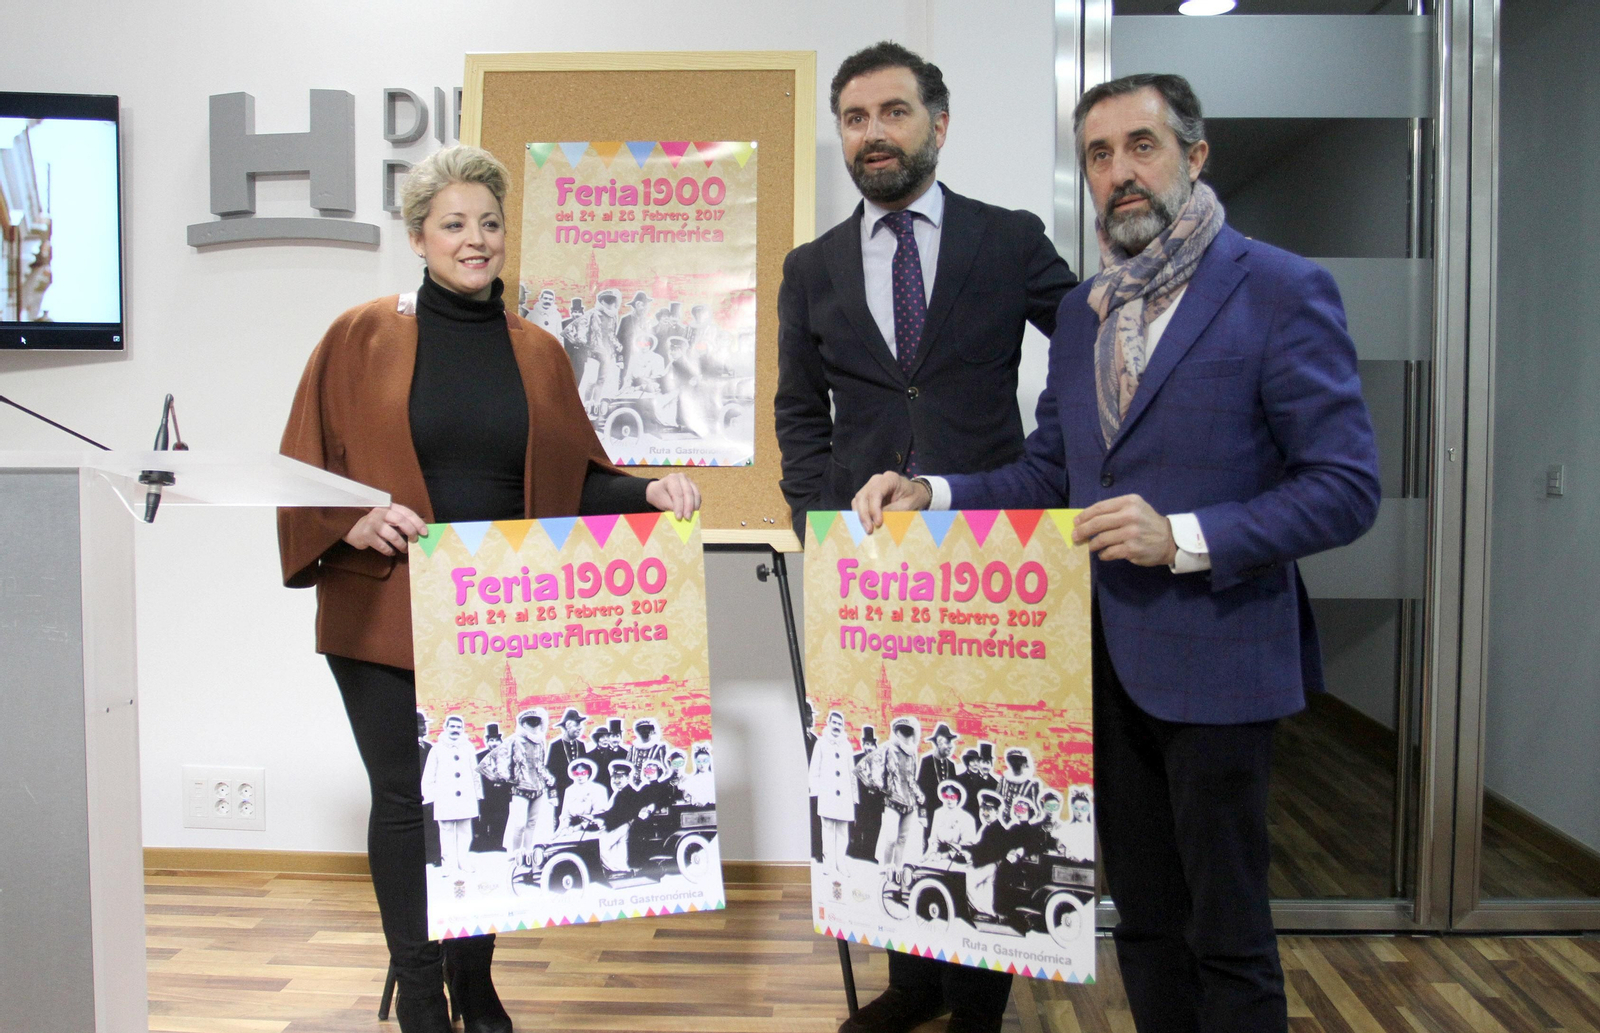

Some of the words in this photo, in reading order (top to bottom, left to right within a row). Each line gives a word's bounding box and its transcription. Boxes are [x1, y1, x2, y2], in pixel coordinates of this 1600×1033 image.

[209, 88, 356, 216] H
[555, 177, 638, 206] Feria
[641, 176, 726, 206] 1900
[555, 210, 573, 221] del
[580, 210, 595, 222] 24
[602, 210, 613, 221] al
[619, 210, 635, 221] 26
[642, 210, 689, 221] Febrero
[695, 209, 725, 221] 2017
[649, 446, 671, 455] Ruta
[451, 566, 559, 606] Feria
[561, 557, 667, 599] 1900
[837, 558, 935, 601] Feria
[939, 561, 1048, 604] 1900
[455, 611, 479, 626] del
[486, 609, 506, 624] 24
[515, 608, 529, 623] al
[536, 606, 557, 621] 26
[565, 603, 624, 619] Febrero
[631, 599, 668, 615] 2017
[839, 605, 858, 620] del
[865, 605, 883, 622] 24
[891, 607, 904, 623] al
[911, 607, 931, 623] 26
[939, 607, 1000, 626] Febrero
[1007, 609, 1047, 627] 2017
[598, 897, 625, 908] Ruta
[630, 890, 704, 905] Gastronómica
[962, 937, 988, 952] Ruta
[993, 943, 1073, 966] Gastronómica
